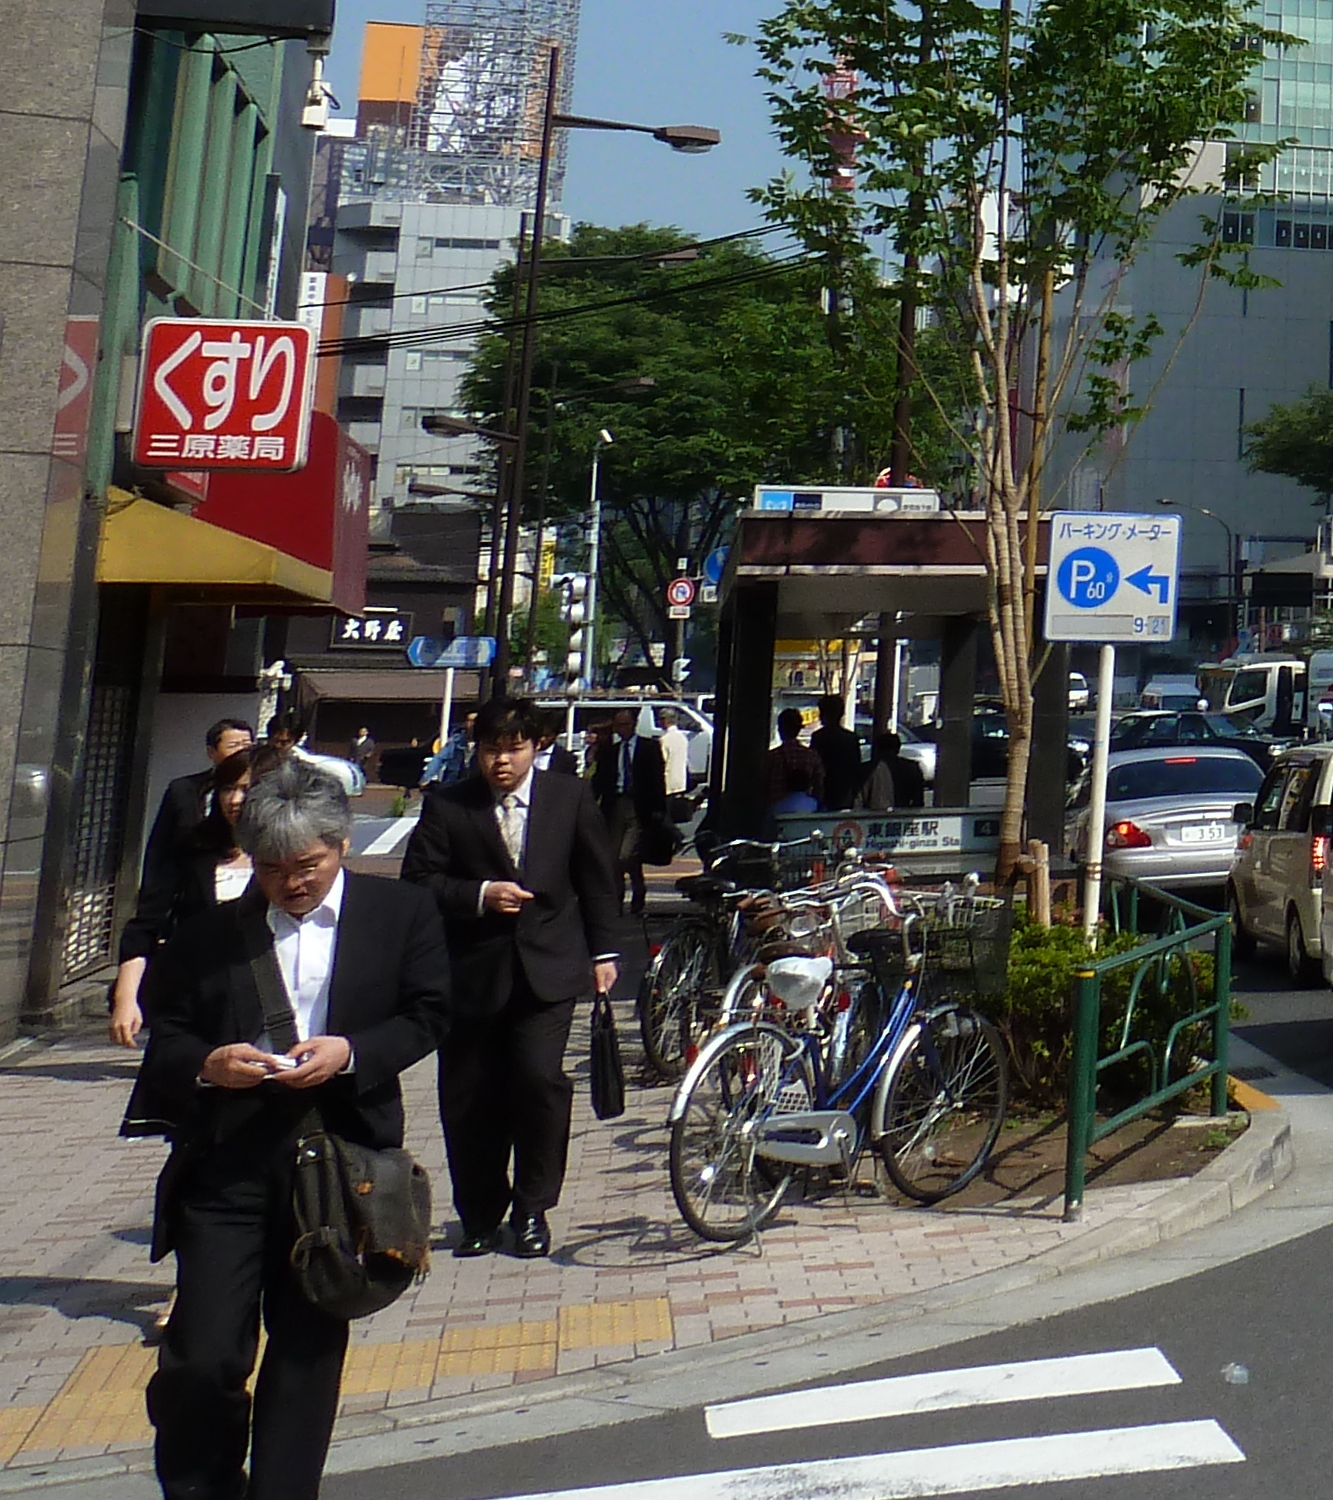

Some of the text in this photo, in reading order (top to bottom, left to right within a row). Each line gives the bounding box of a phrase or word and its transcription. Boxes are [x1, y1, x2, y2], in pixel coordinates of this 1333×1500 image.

[154, 331, 296, 432] くすり
[147, 434, 285, 461] 三原薬局
[867, 819, 940, 839] 東銀座駅
